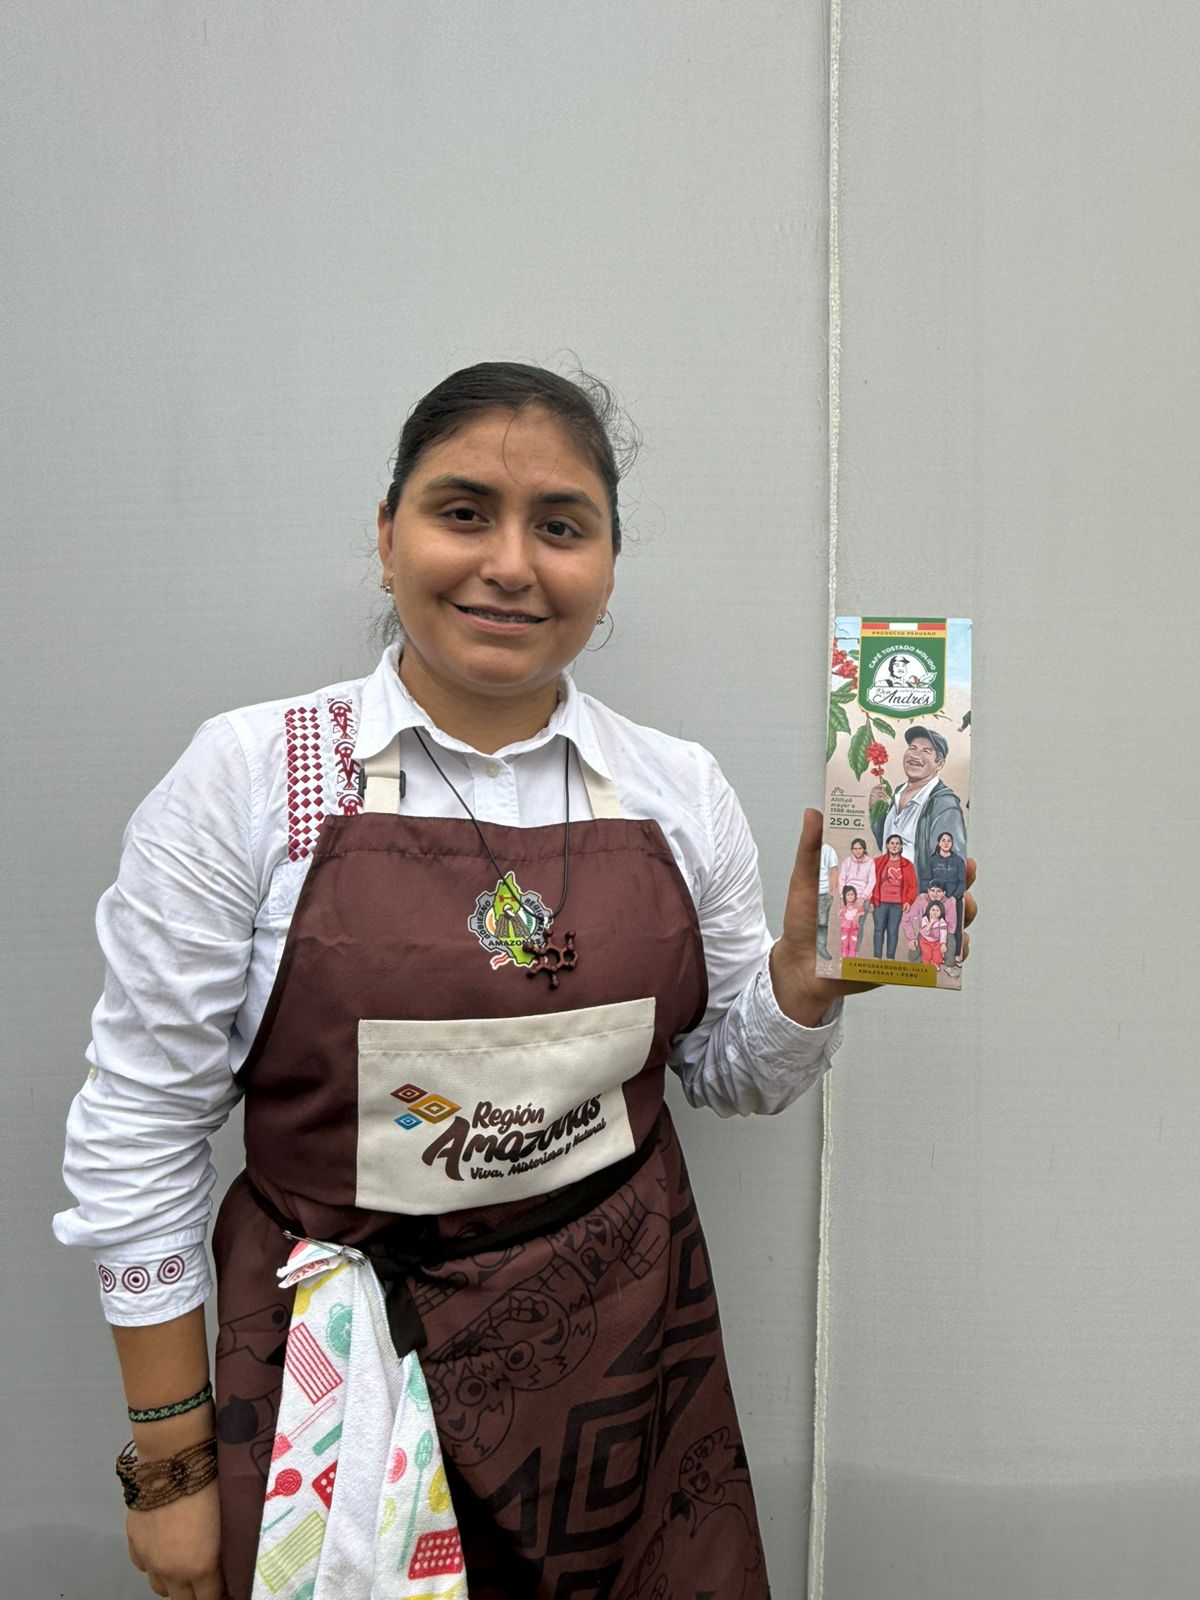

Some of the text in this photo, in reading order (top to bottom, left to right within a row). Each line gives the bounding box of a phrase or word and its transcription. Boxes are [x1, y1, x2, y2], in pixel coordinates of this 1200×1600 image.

[869, 645, 936, 670] CAFÉ TOSTADO MOLIDO
[873, 689, 931, 706] Andrés
[829, 817, 865, 827] 250 G.
[477, 900, 491, 939] GOBIERNO
[472, 1101, 545, 1134] Región
[470, 1167, 504, 1180] Viva,
[507, 1146, 564, 1176] Misteriosa
